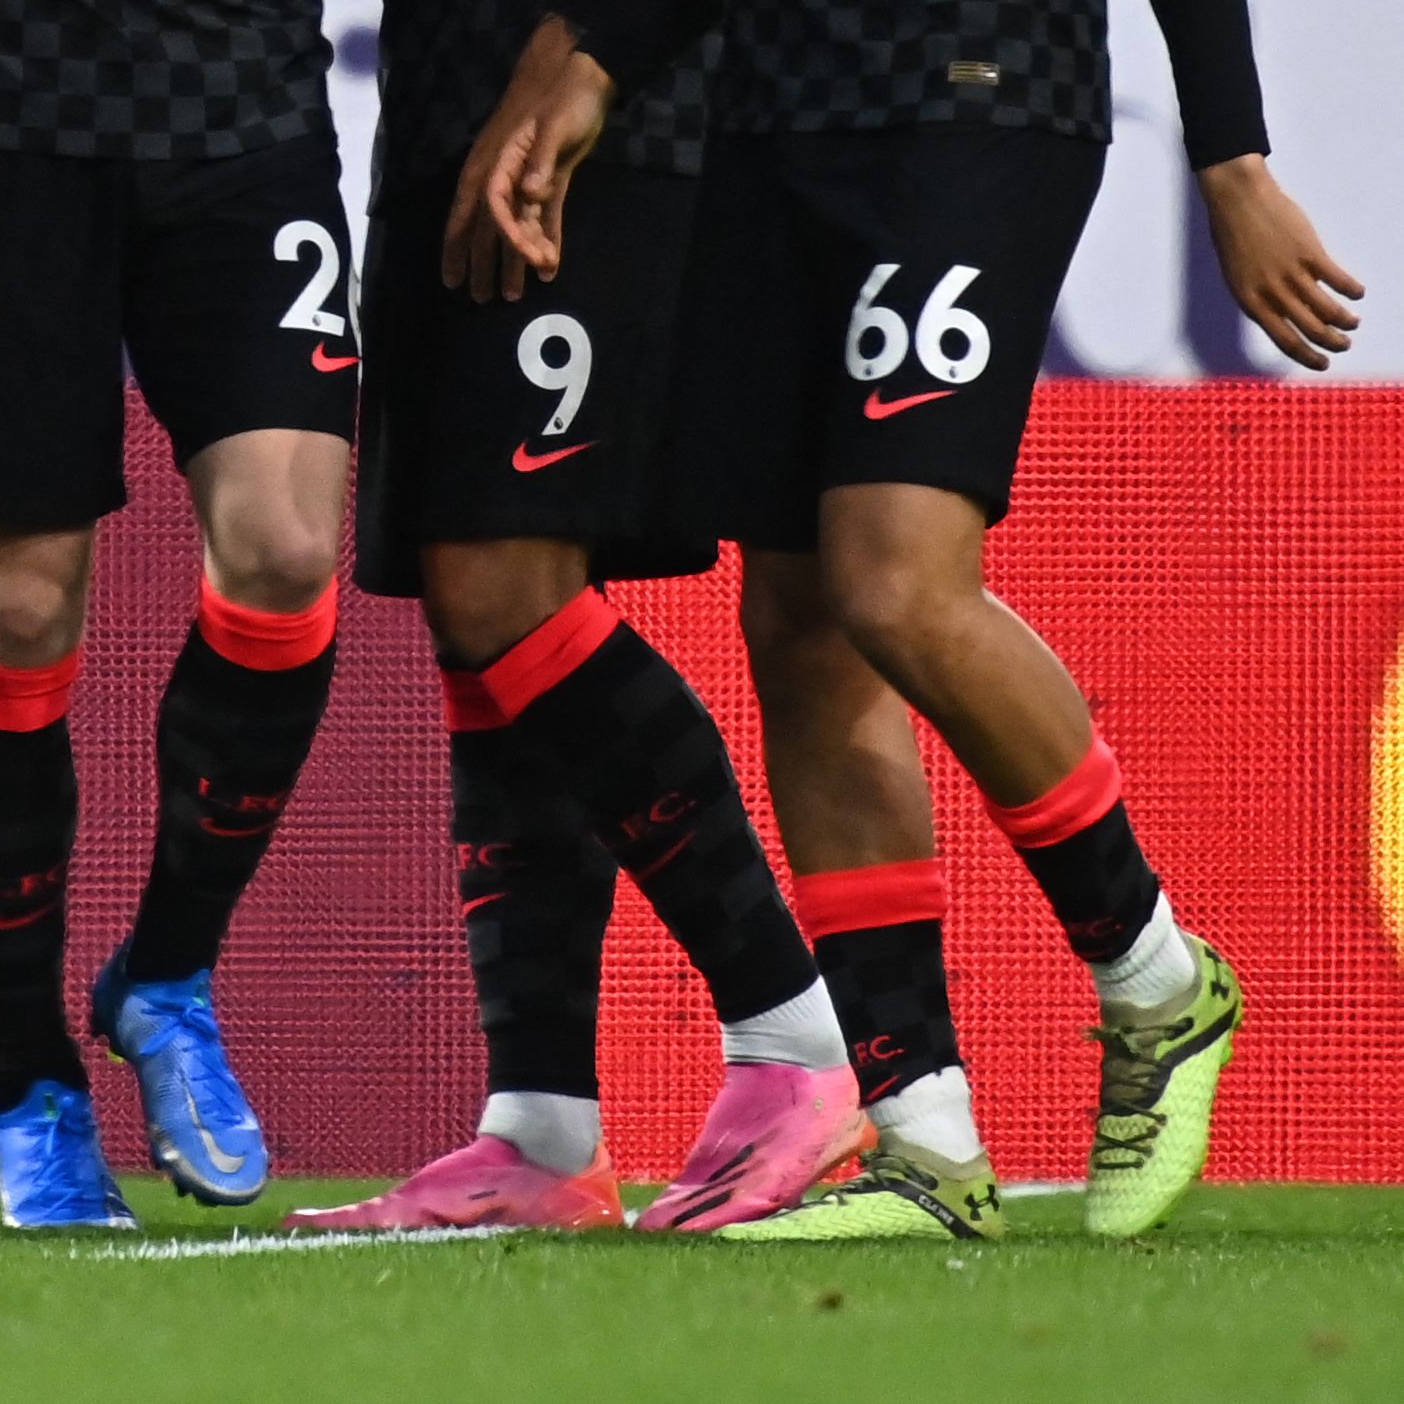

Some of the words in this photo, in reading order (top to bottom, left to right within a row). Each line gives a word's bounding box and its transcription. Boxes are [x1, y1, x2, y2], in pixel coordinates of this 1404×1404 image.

[273, 219, 362, 337] 2
[845, 263, 992, 384] 66
[517, 313, 593, 436] 9
